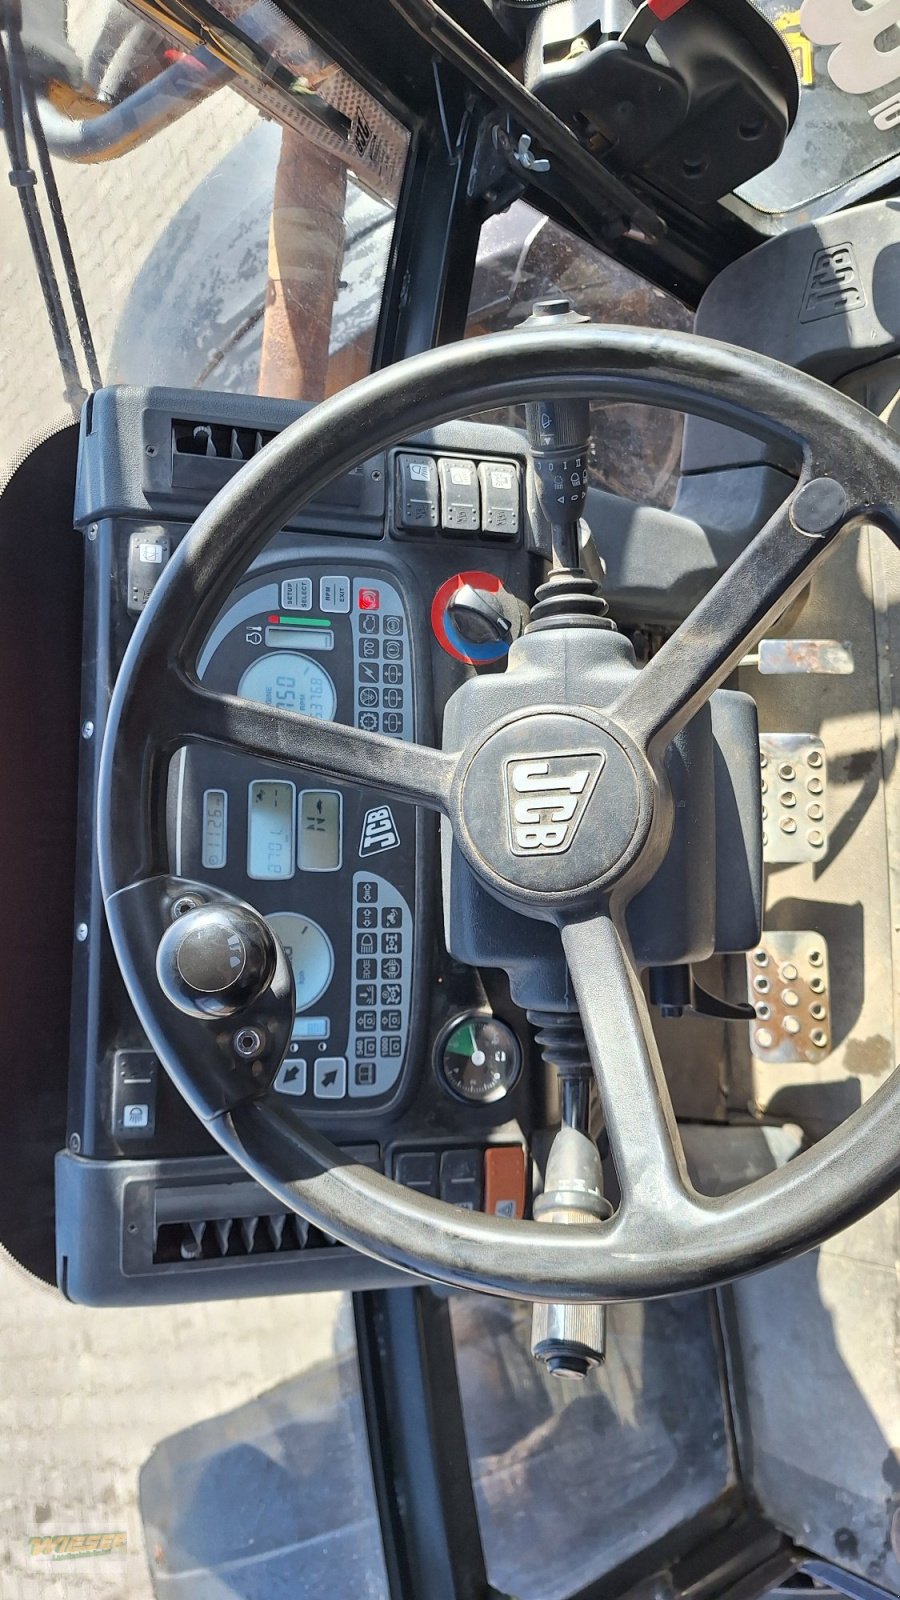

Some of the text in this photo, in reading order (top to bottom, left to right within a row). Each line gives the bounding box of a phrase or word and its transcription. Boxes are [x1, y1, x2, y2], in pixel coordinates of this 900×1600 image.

[805, 248, 861, 312] JCB
[306, 816, 326, 832] N
[363, 809, 396, 849] JCB
[512, 762, 590, 850] JCB
